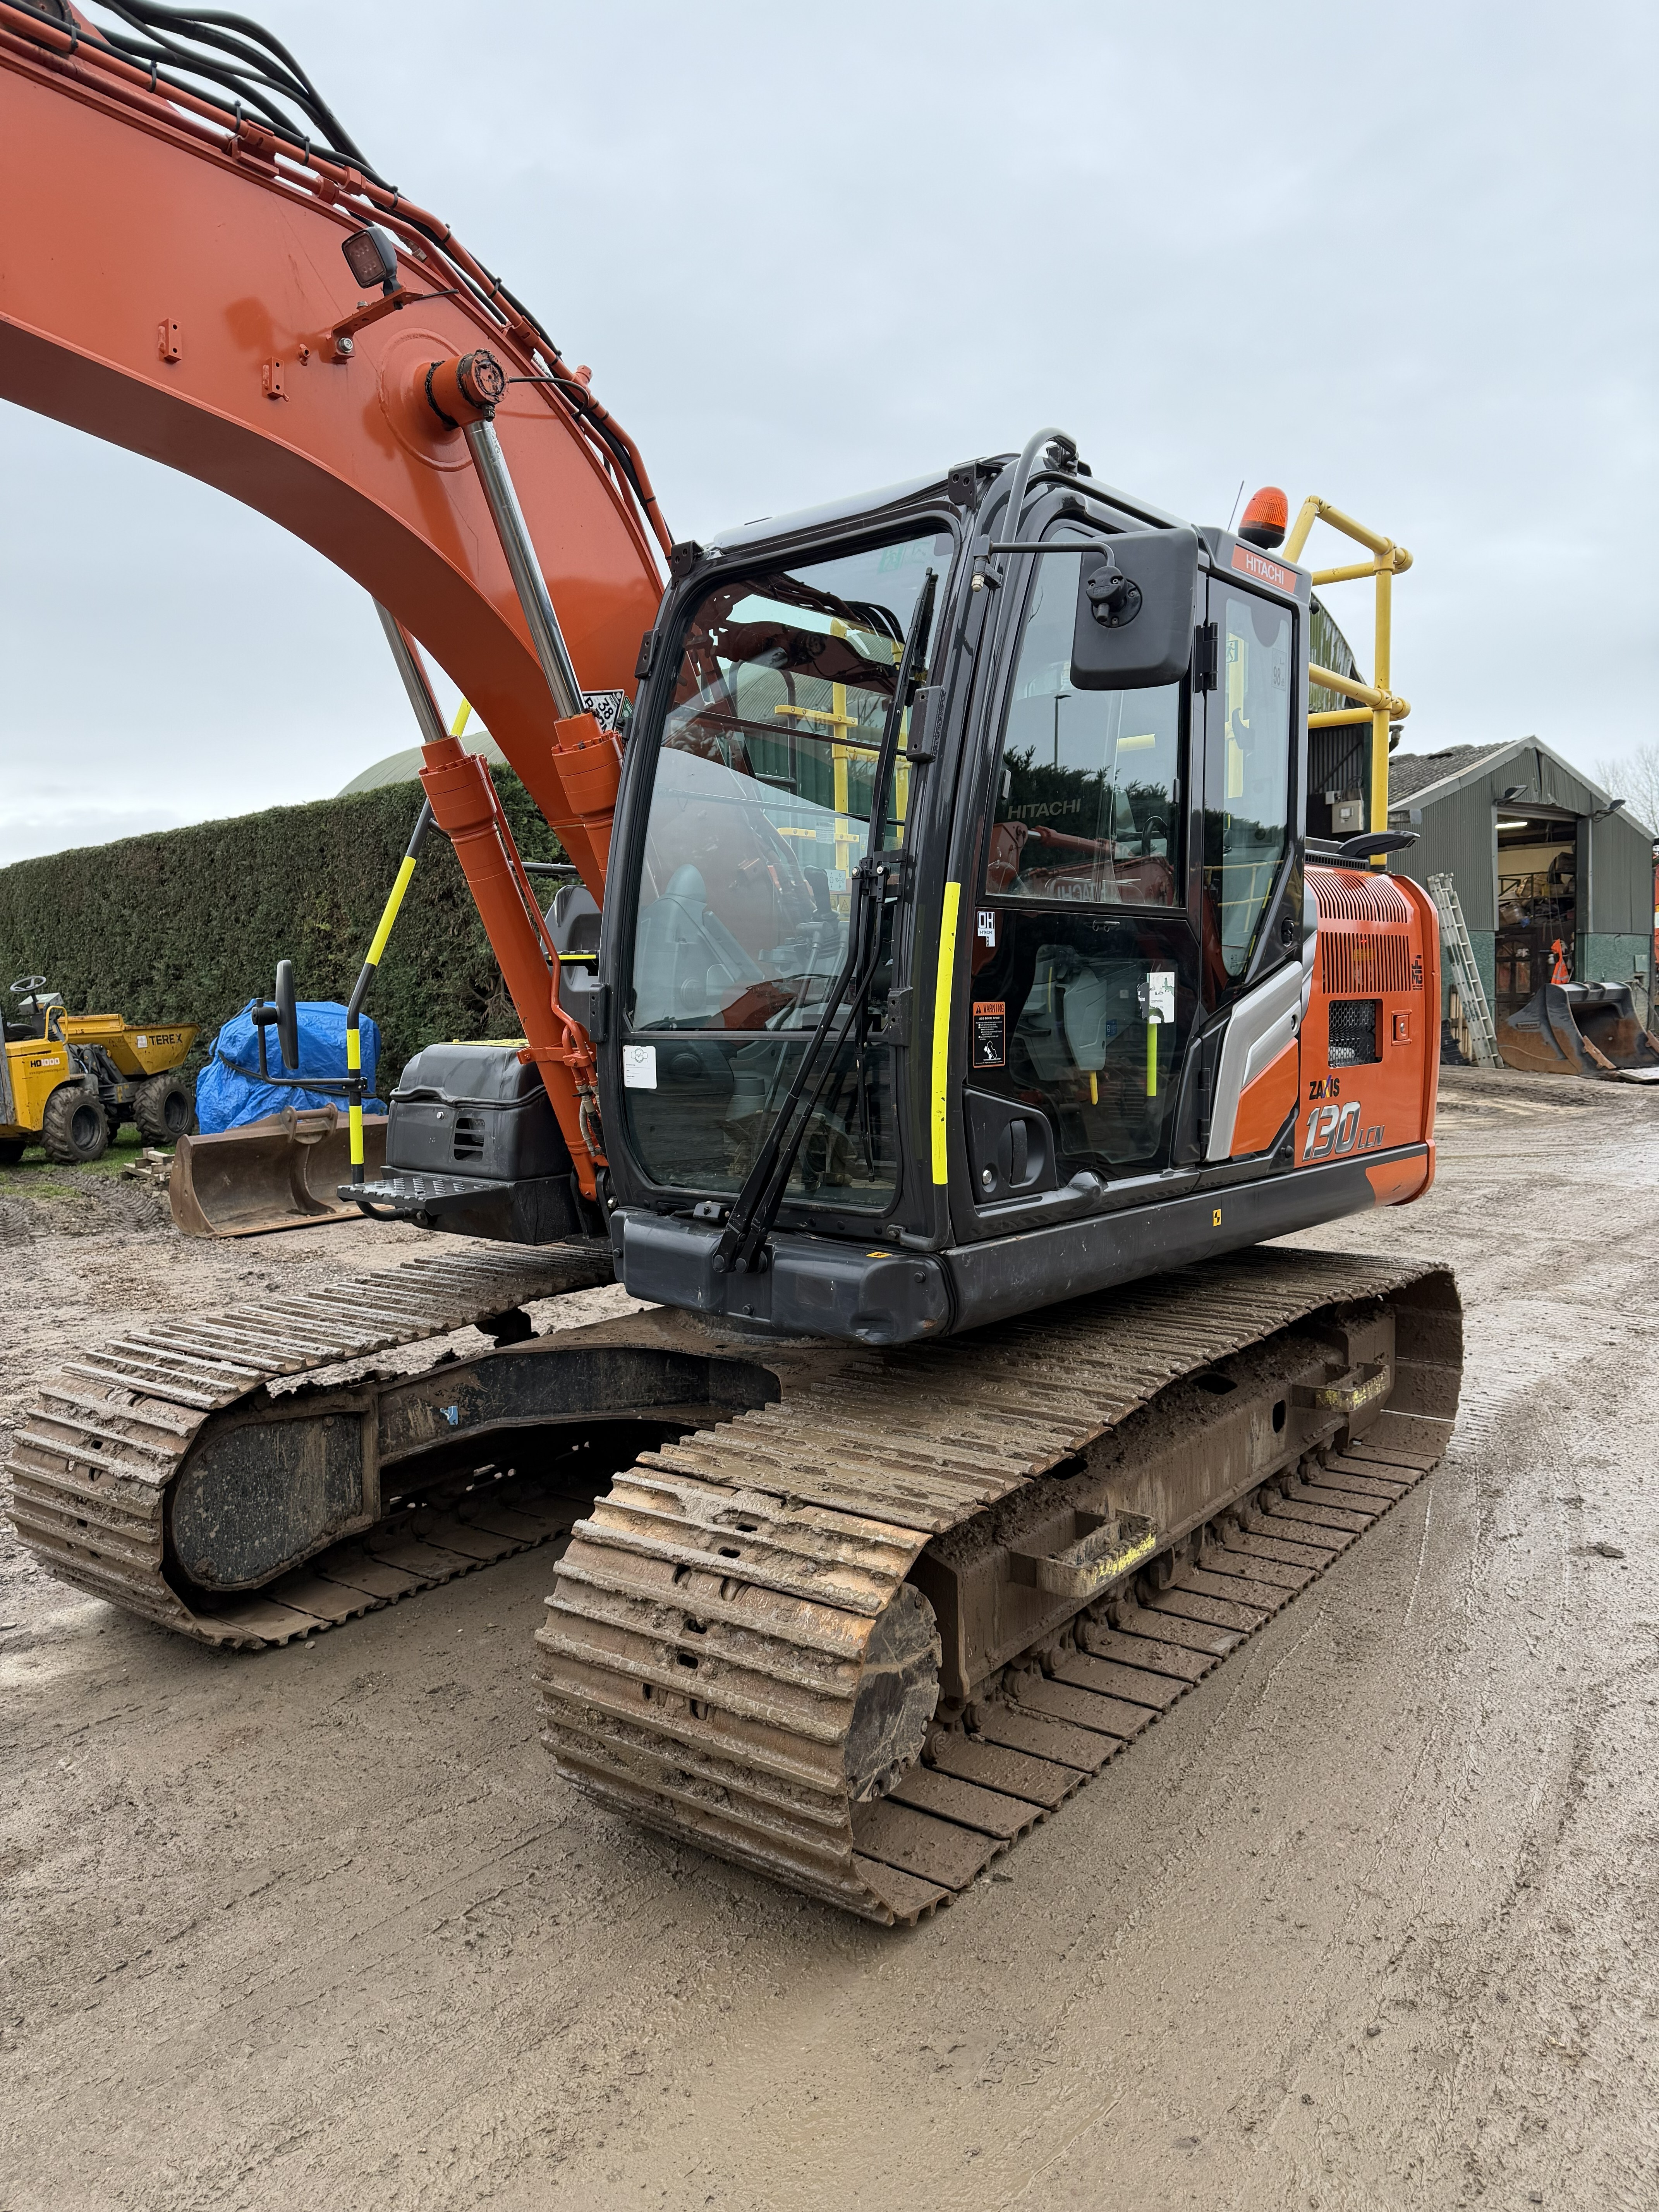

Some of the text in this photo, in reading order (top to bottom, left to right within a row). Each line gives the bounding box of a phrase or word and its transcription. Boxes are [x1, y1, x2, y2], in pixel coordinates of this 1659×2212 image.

[1246, 553, 1284, 585] HITACHI
[1273, 666, 1281, 686] 98
[598, 697, 614, 720] 38
[1007, 798, 1081, 819] HITACHI
[978, 912, 994, 929] OK
[983, 1004, 1004, 1013] WARNING
[149, 1033, 183, 1046] TEREX
[30, 1057, 60, 1068] HD1000
[1309, 1074, 1340, 1100] ZAXIS
